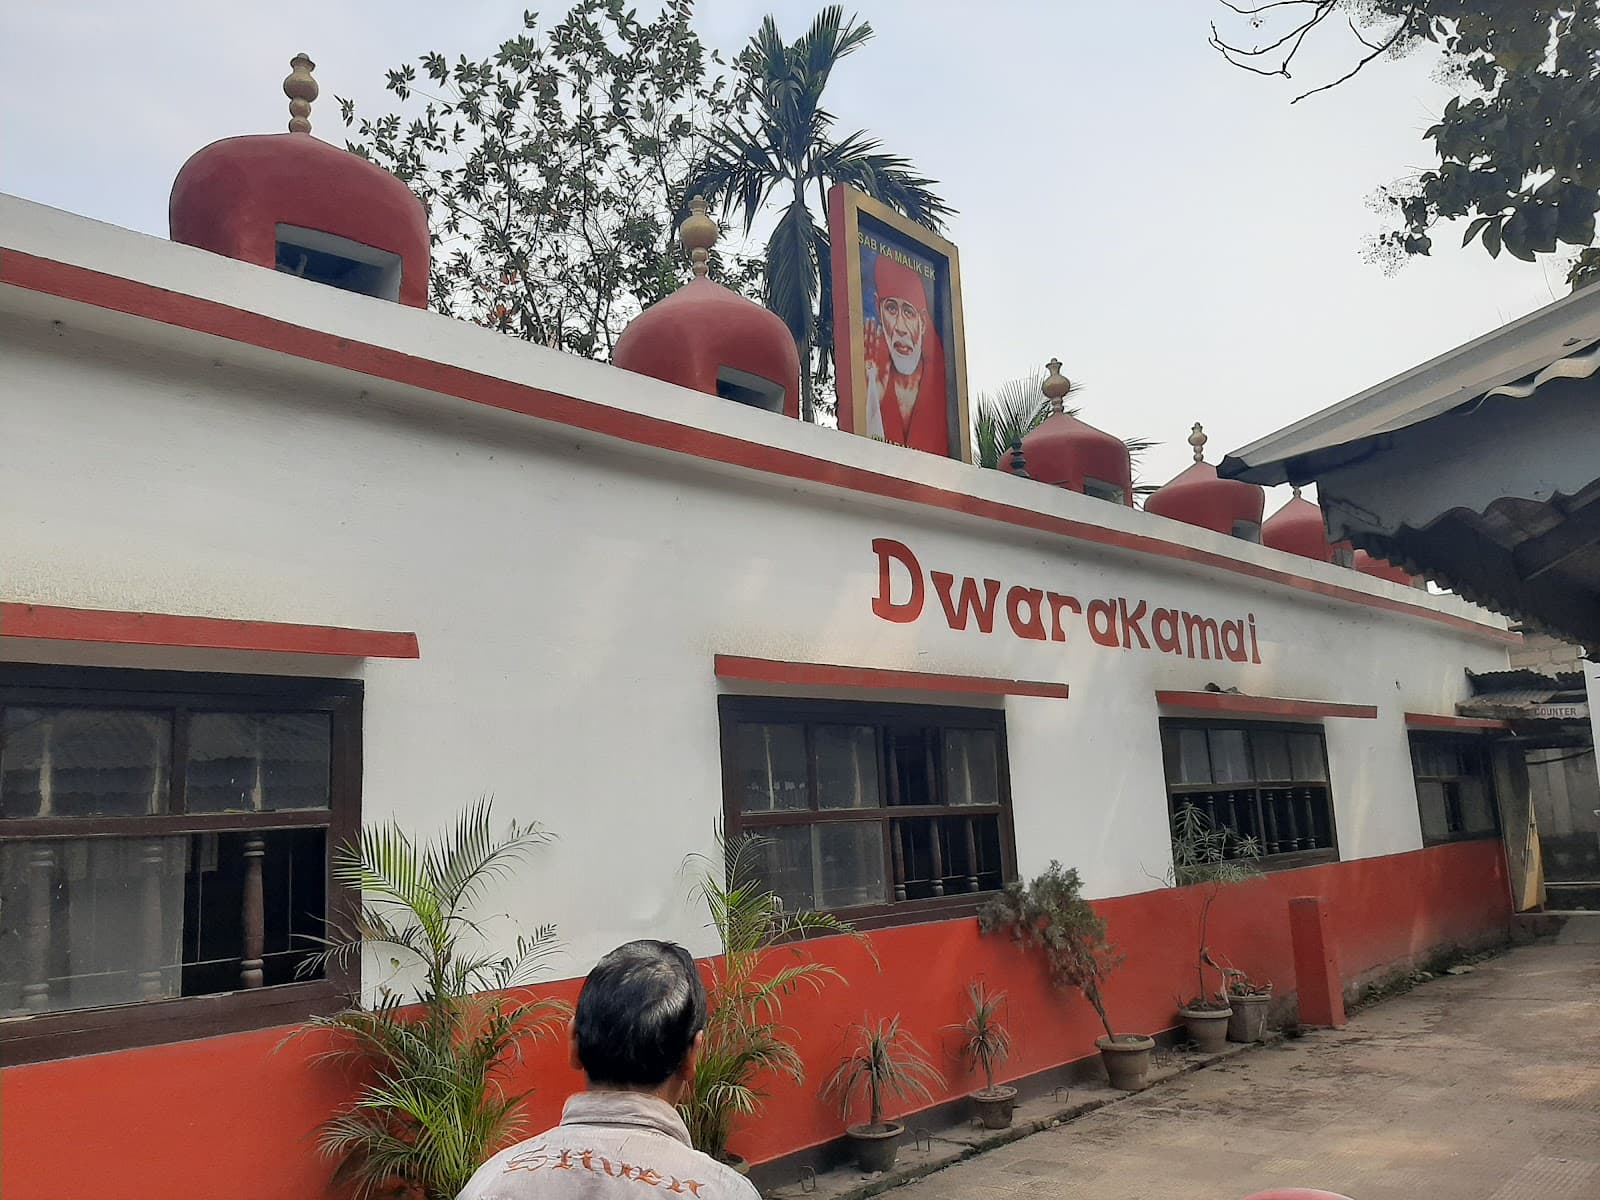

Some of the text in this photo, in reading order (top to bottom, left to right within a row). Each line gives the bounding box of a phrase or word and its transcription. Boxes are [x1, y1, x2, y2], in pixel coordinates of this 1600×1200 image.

[857, 231, 936, 281] SAB KA MALIK EK
[871, 537, 1262, 665] Dwarakamai
[1534, 707, 1577, 717] COUNTER
